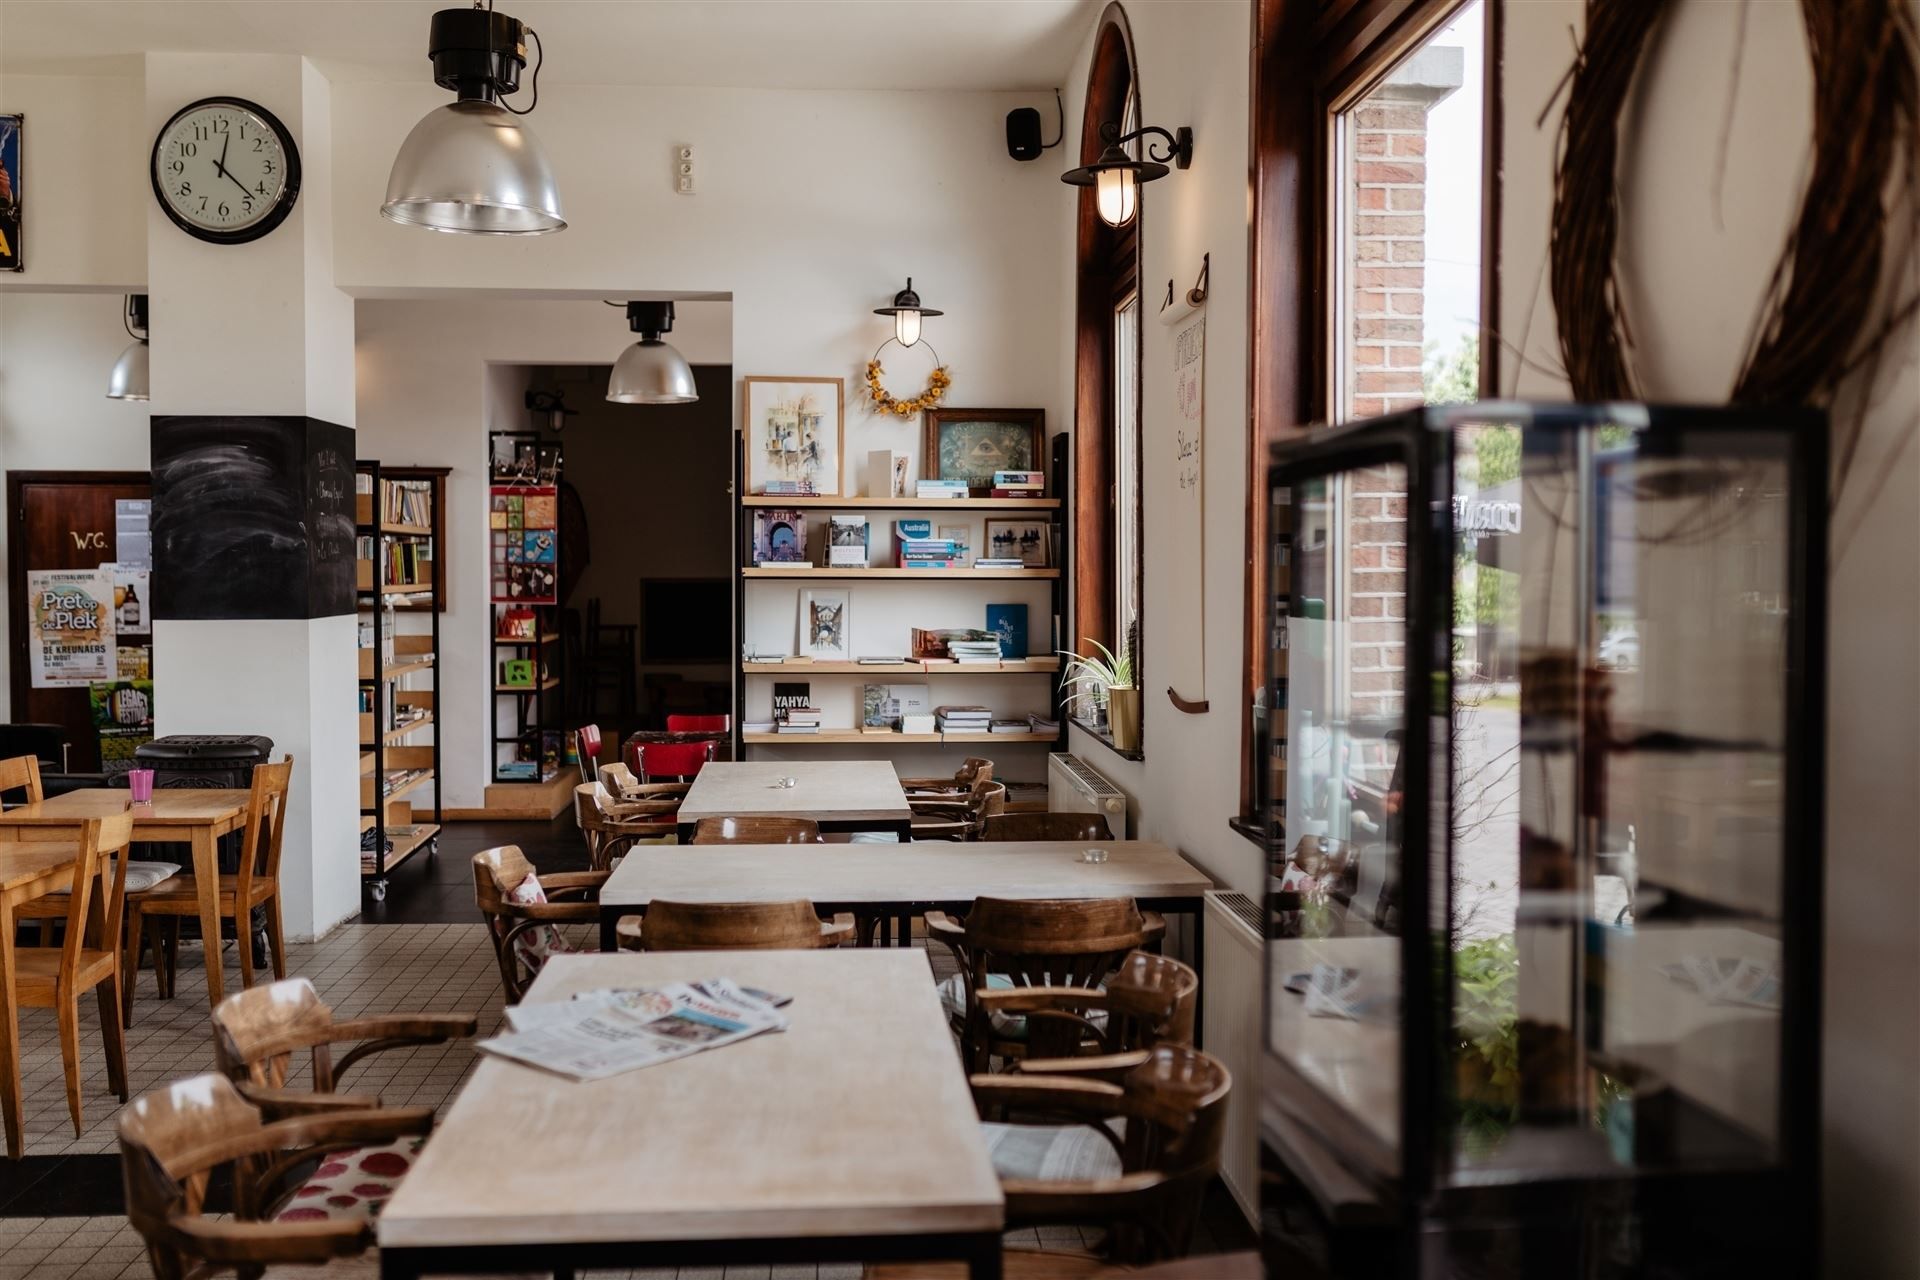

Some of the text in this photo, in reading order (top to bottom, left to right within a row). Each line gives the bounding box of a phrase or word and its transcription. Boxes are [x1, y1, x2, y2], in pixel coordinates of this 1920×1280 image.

[195, 126, 208, 140] 11
[213, 119, 229, 133] 12
[240, 125, 245, 139] 1
[181, 142, 197, 157] 10
[253, 138, 263, 152] 2
[172, 160, 184, 176] 9
[262, 160, 272, 174] 3
[180, 181, 192, 196] 8
[254, 180, 266, 195] 4
[198, 196, 208, 210] 7
[218, 201, 230, 216] 6
[242, 195, 252, 210] 5
[42, 592, 98, 610] Pret op
[42, 611, 98, 630] de Plek
[43, 645, 106, 654] DE KREUNAERS
[774, 695, 810, 708] YAHYA
